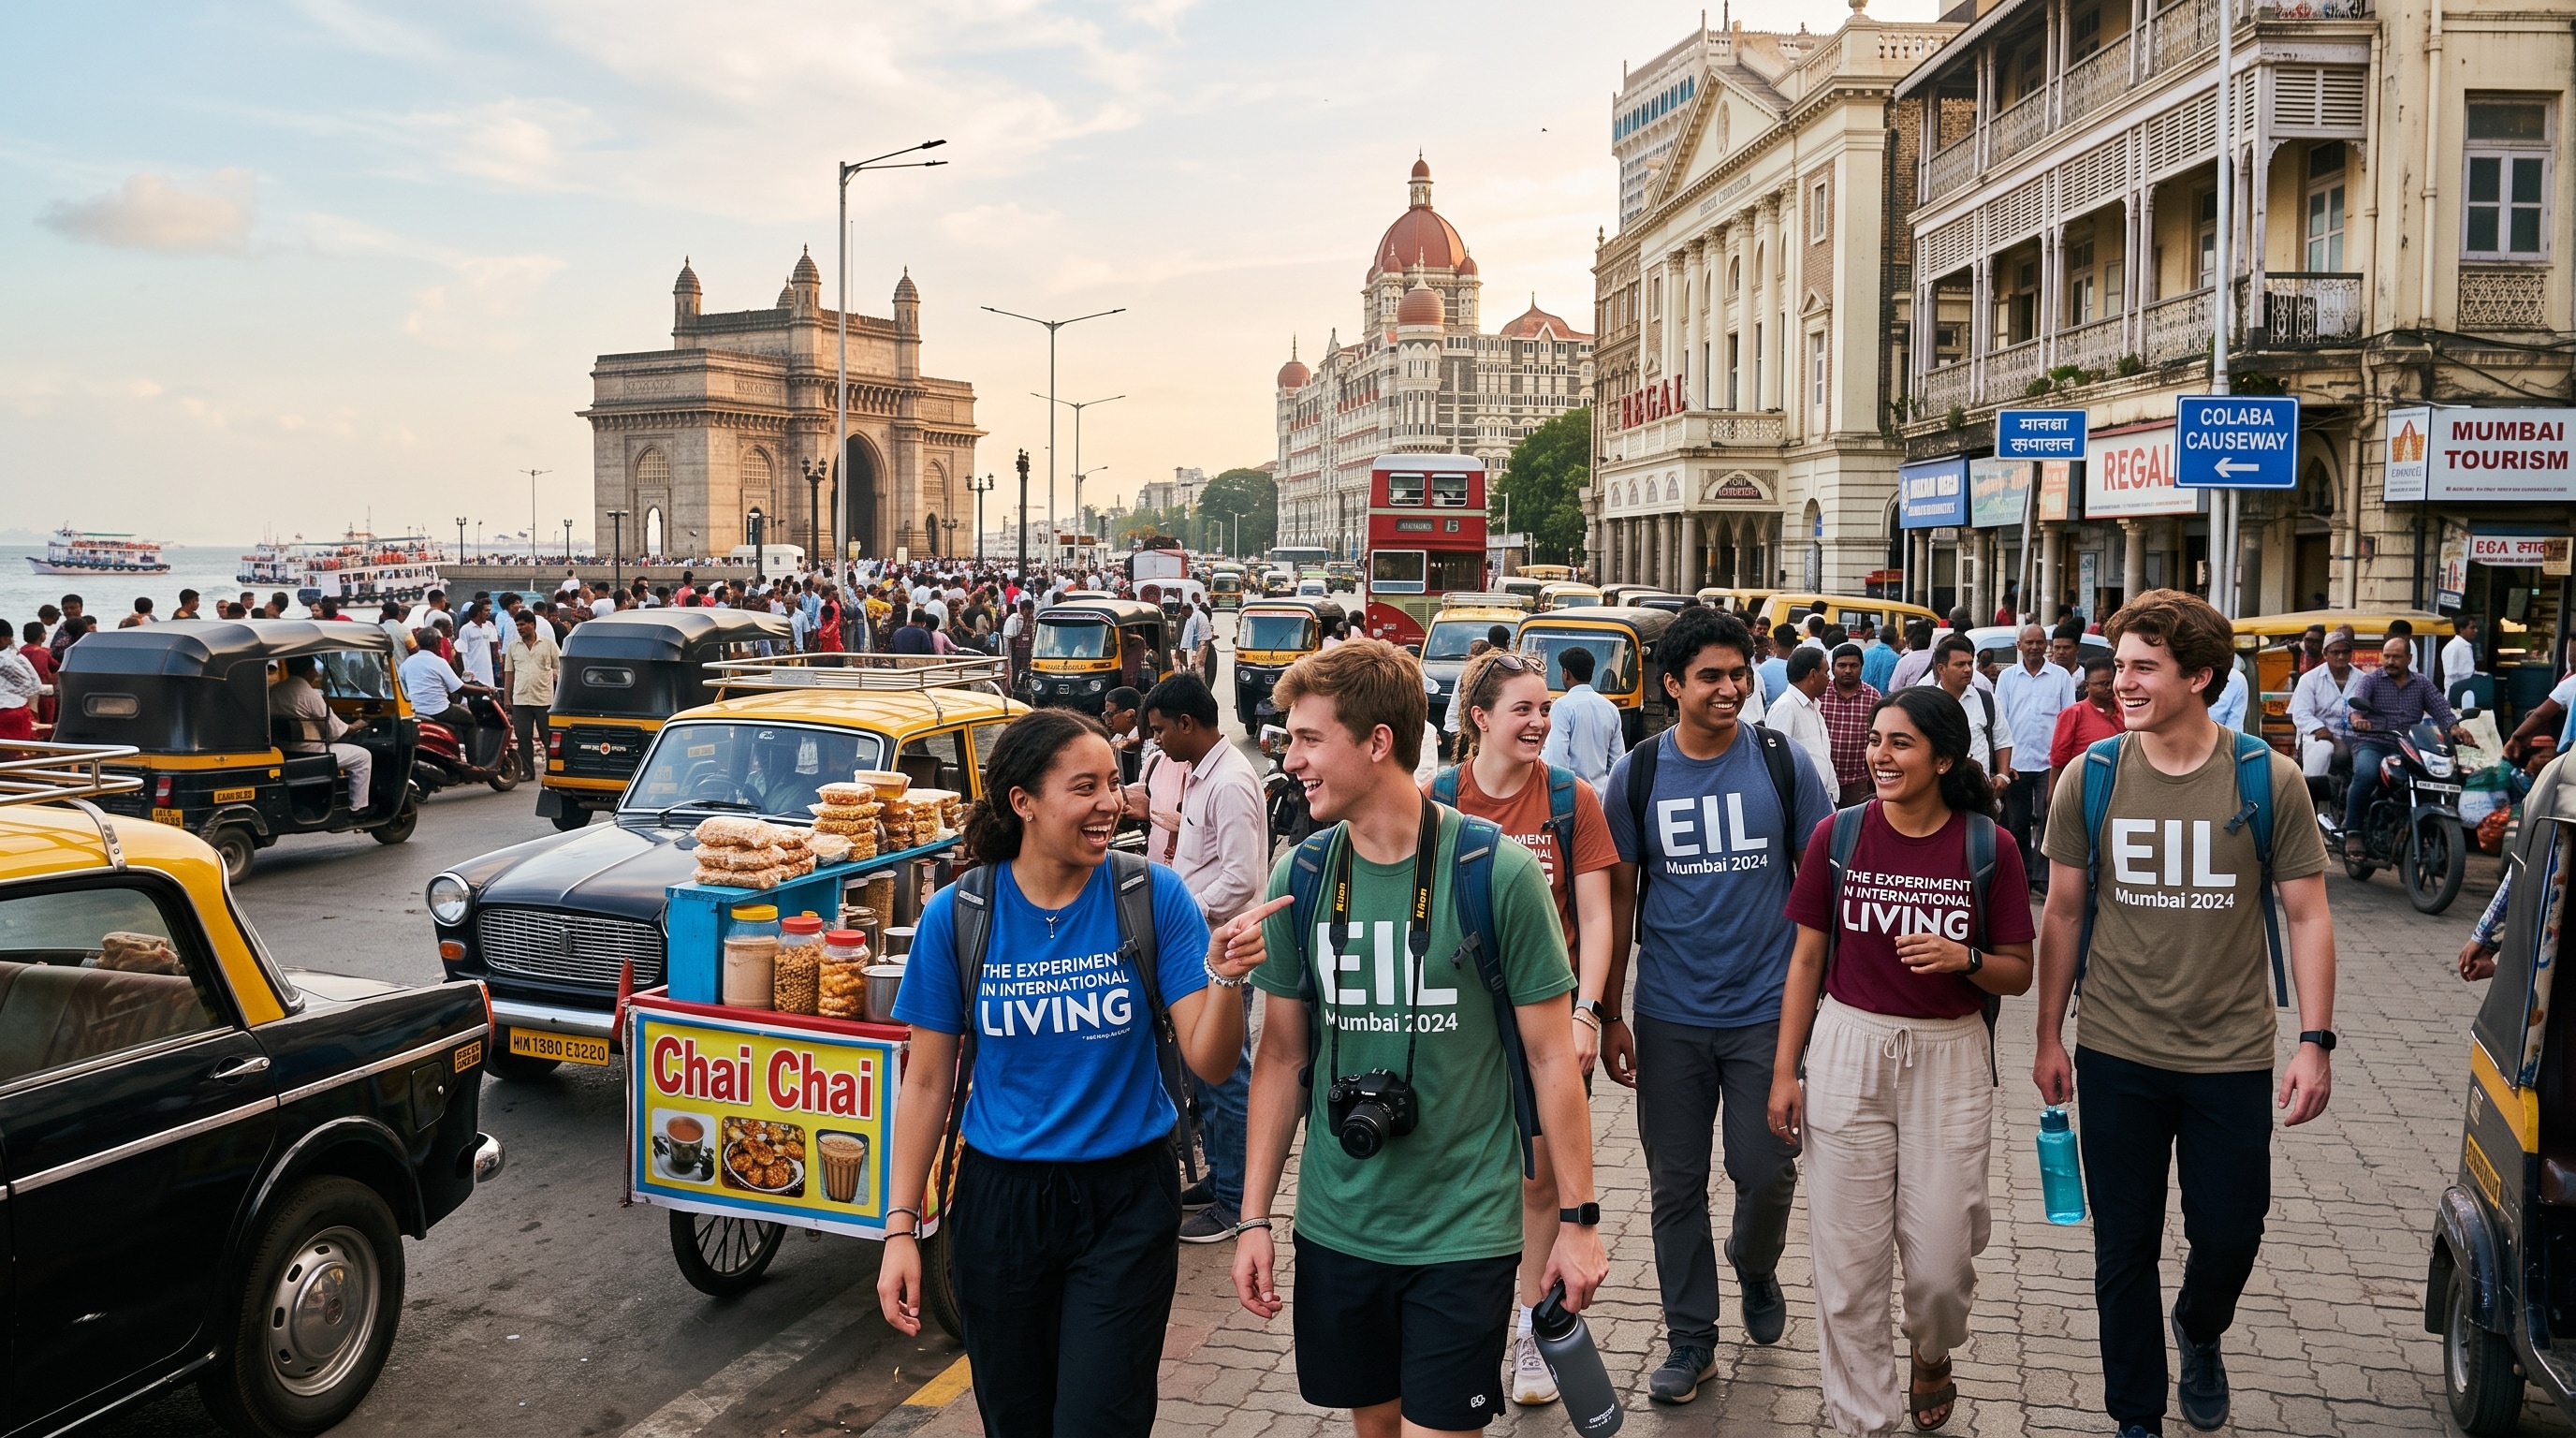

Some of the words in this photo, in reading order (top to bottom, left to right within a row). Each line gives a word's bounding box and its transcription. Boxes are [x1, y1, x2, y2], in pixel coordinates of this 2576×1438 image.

[1620, 374, 1686, 430] REGAL
[2200, 407, 2276, 426] COLABA
[2186, 431, 2289, 450] CAUSEWAY
[2452, 421, 2564, 441] MUMBAI
[2104, 444, 2174, 491] REGAL
[2444, 449, 2569, 470] TOURISM
[1657, 792, 1768, 857] EIL
[1666, 857, 1728, 875] Mumbai
[1731, 854, 1768, 872] 2024
[2112, 818, 2237, 888] EIL
[1846, 869, 1871, 884] THE
[1875, 873, 1971, 892] EXPERIMENT
[1856, 887, 1971, 907] INTERNATIONAL
[2115, 888, 2186, 909] Mumbai
[2190, 892, 2234, 909] 2024
[1842, 899, 1969, 941] LIVING
[983, 963, 1012, 978] THE
[1017, 951, 1120, 978] EXPERIMEN
[1316, 920, 1458, 1005] EIL
[982, 982, 996, 996] IN
[1000, 969, 1130, 997] INTERNATIONAL
[981, 988, 1132, 1036] LIVING
[1325, 1008, 1399, 1033] Mumbai
[1404, 1012, 1458, 1033] 2024
[652, 1034, 753, 1107] Chai
[767, 1048, 874, 1122] Chai
